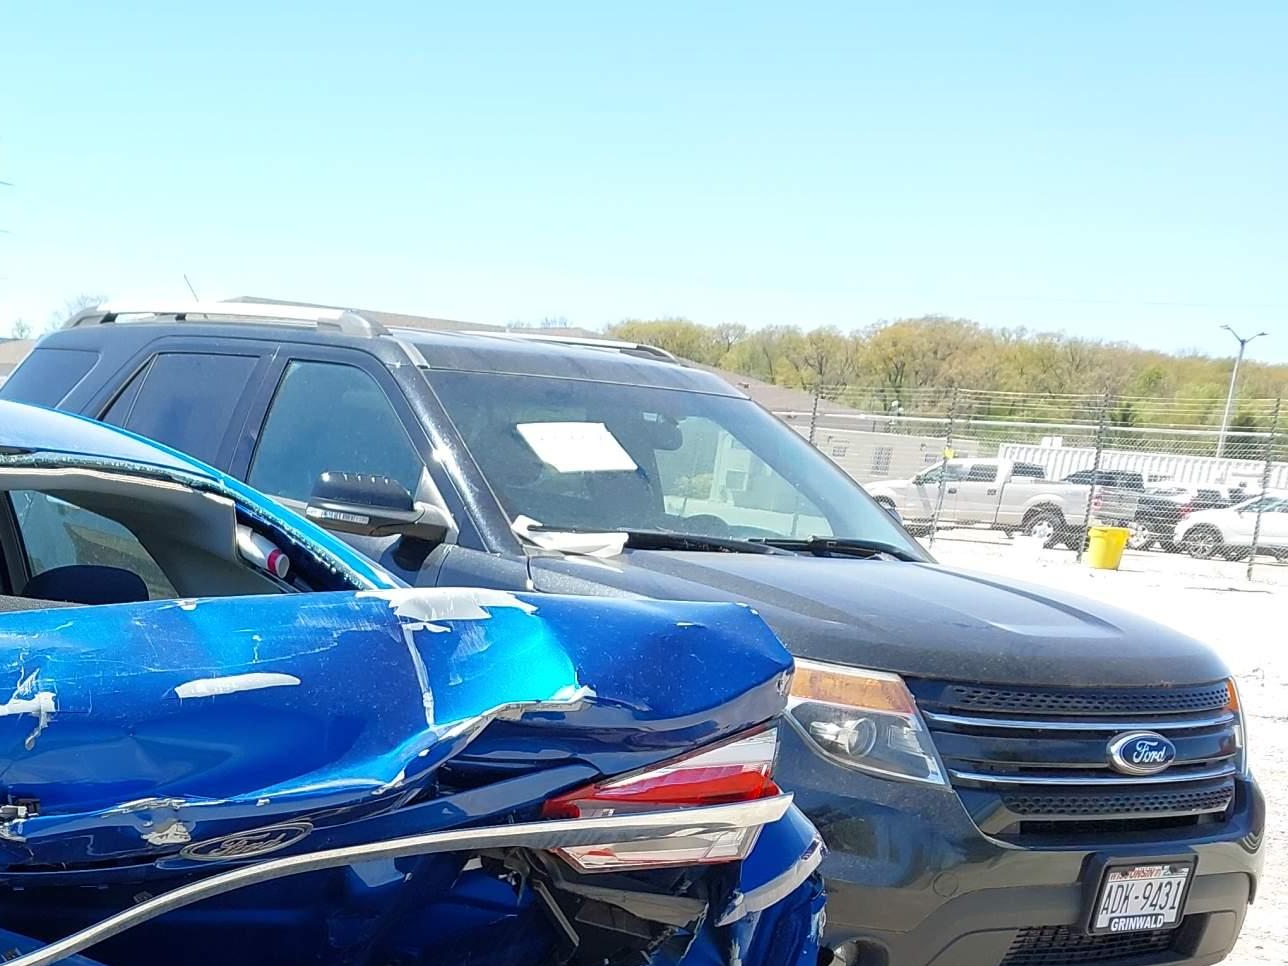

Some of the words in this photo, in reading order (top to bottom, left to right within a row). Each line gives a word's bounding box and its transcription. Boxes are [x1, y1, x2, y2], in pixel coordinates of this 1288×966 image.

[1133, 740, 1167, 763] Ford
[209, 832, 287, 857] Ford
[1100, 881, 1182, 915] ADK-9431
[1110, 915, 1165, 932] GRINWALD
